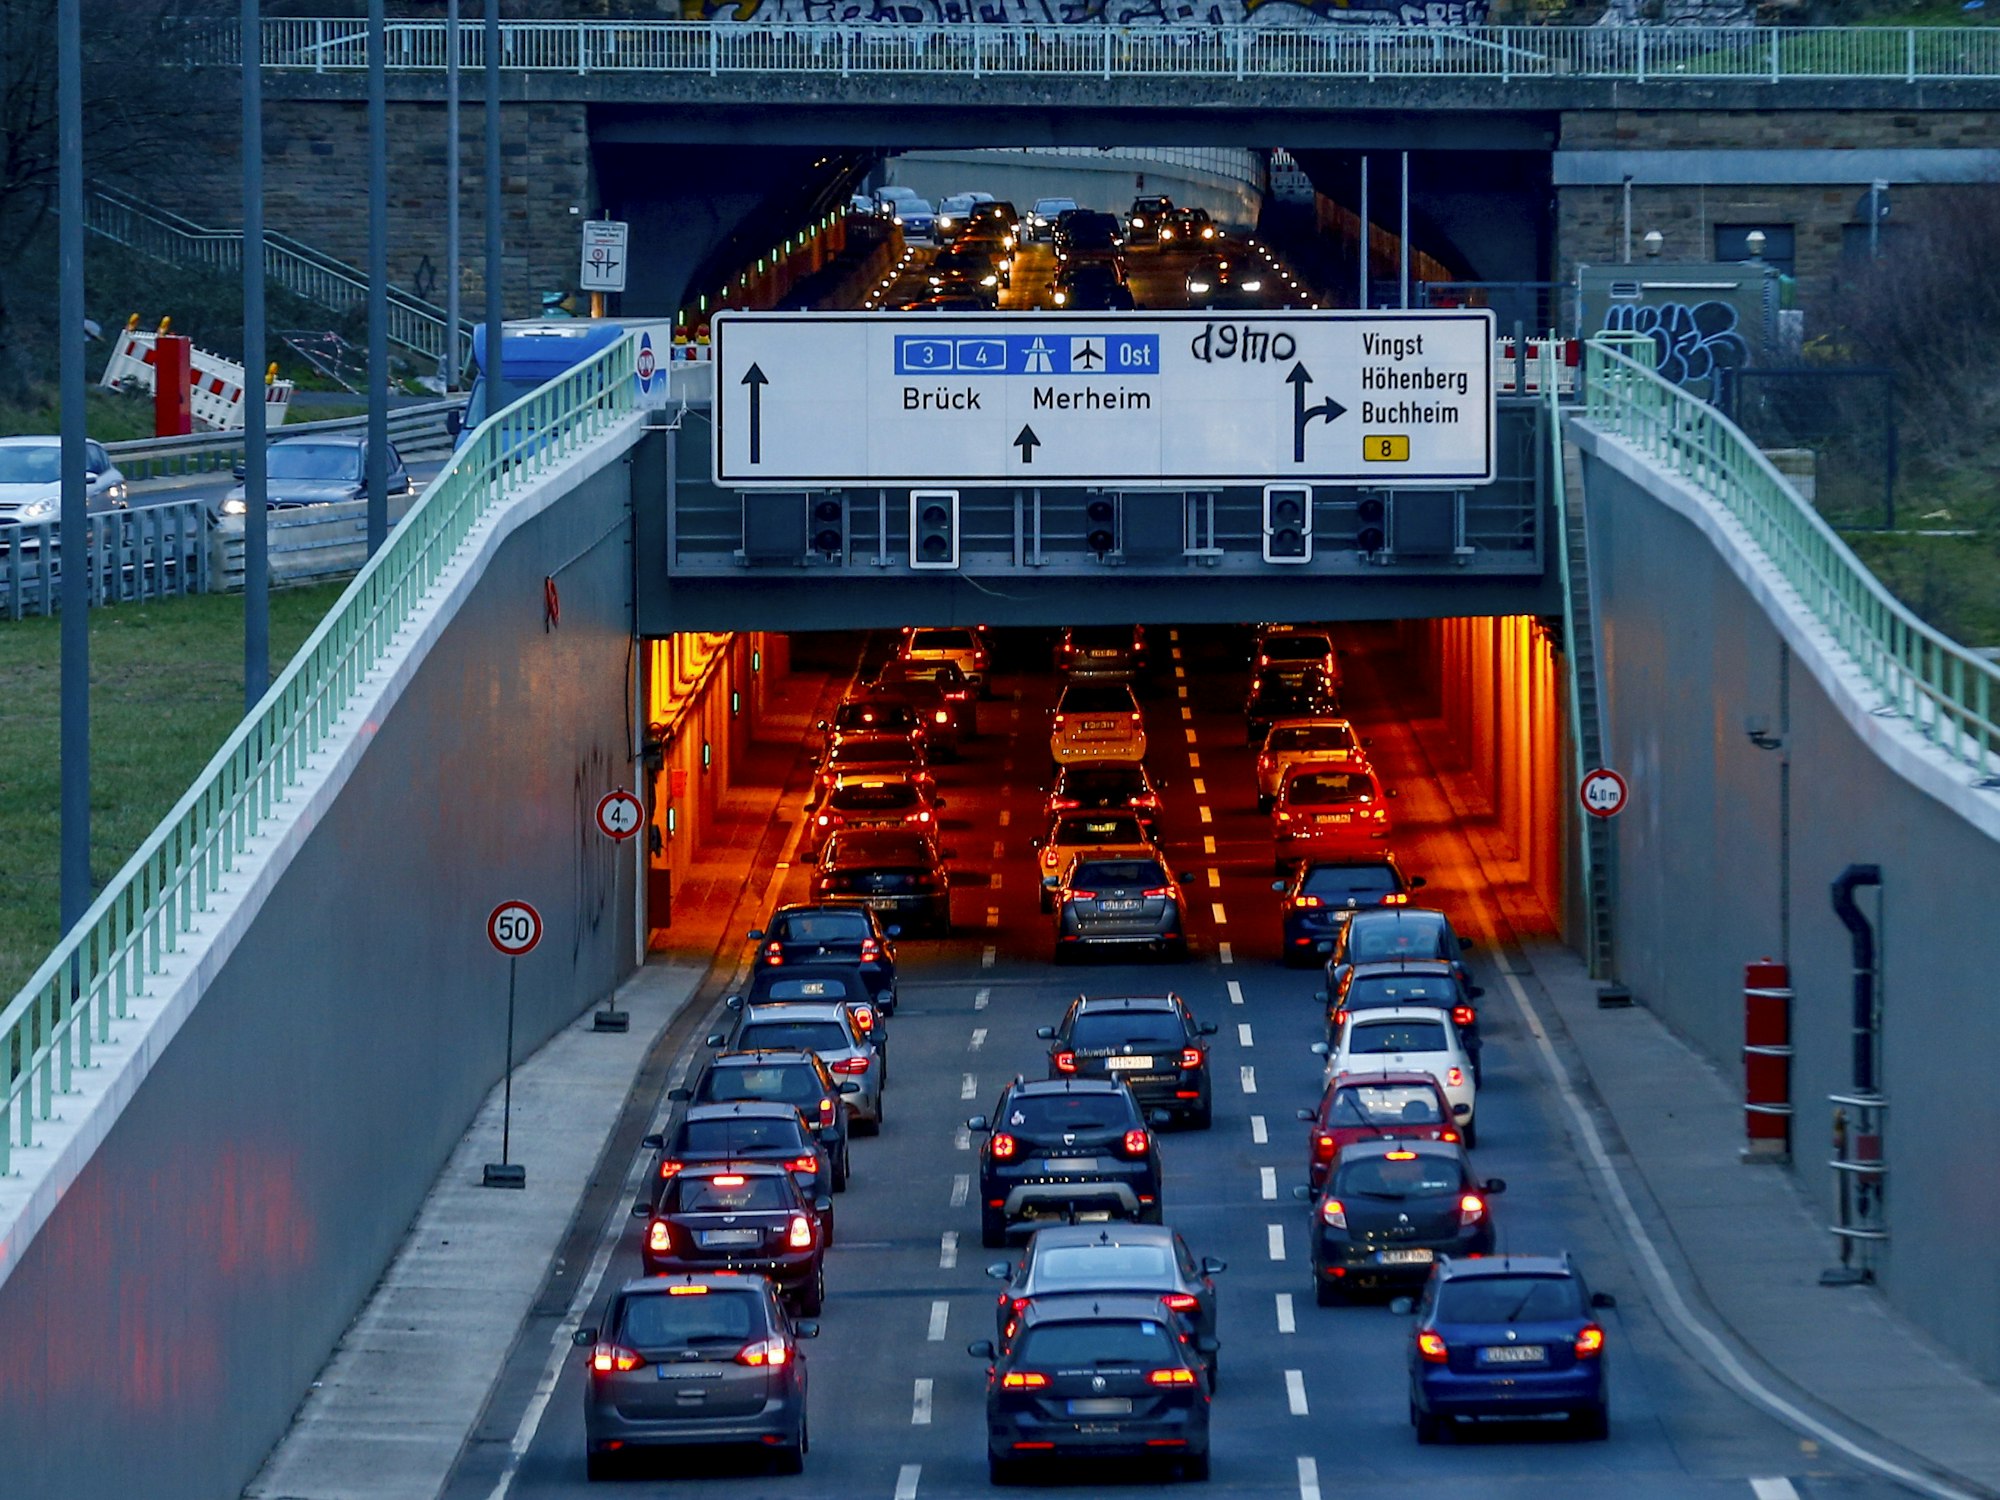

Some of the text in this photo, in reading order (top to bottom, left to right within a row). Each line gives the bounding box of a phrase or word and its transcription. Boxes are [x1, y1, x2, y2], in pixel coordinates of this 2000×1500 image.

[922, 342, 1151, 366] 3 4 Ost
[1362, 332, 1424, 362] Vingst
[1362, 366, 1468, 395] Höhenberg
[903, 386, 1151, 410] Brück Merheim
[1362, 400, 1459, 424] Buchheim
[1380, 439, 1392, 457] 8
[499, 916, 530, 942] 50
